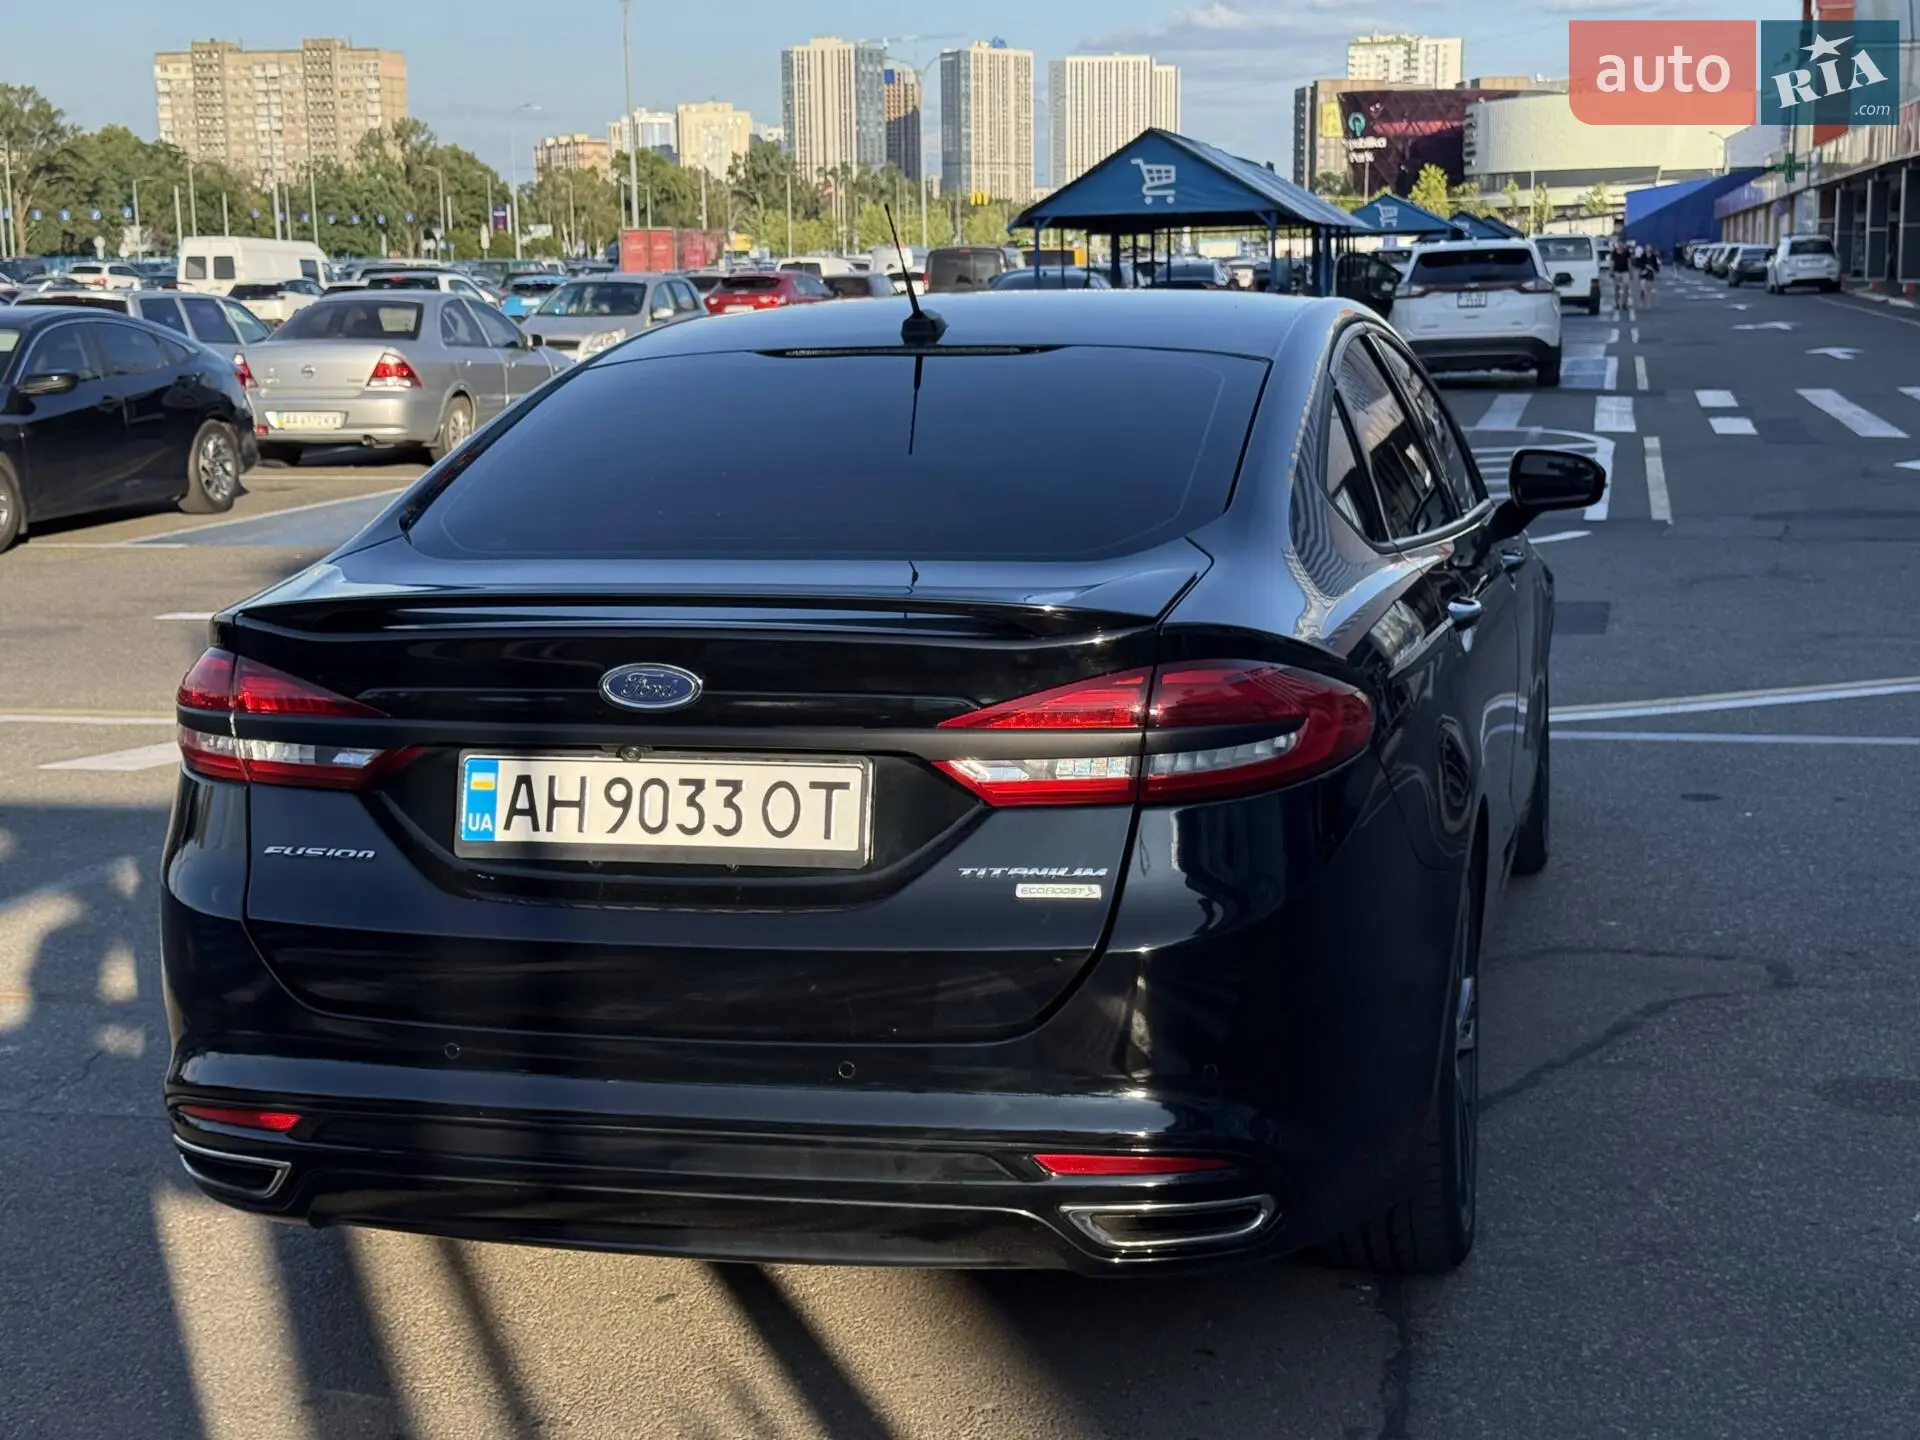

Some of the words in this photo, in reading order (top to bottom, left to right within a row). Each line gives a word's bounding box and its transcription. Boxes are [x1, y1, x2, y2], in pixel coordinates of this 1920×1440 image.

[620, 672, 679, 697] Ford
[503, 773, 588, 833] AH
[603, 776, 744, 838] 9033
[761, 779, 851, 841] OT
[467, 812, 493, 832] UA
[263, 845, 376, 858] FUSION
[957, 867, 1109, 877] TITANIUM
